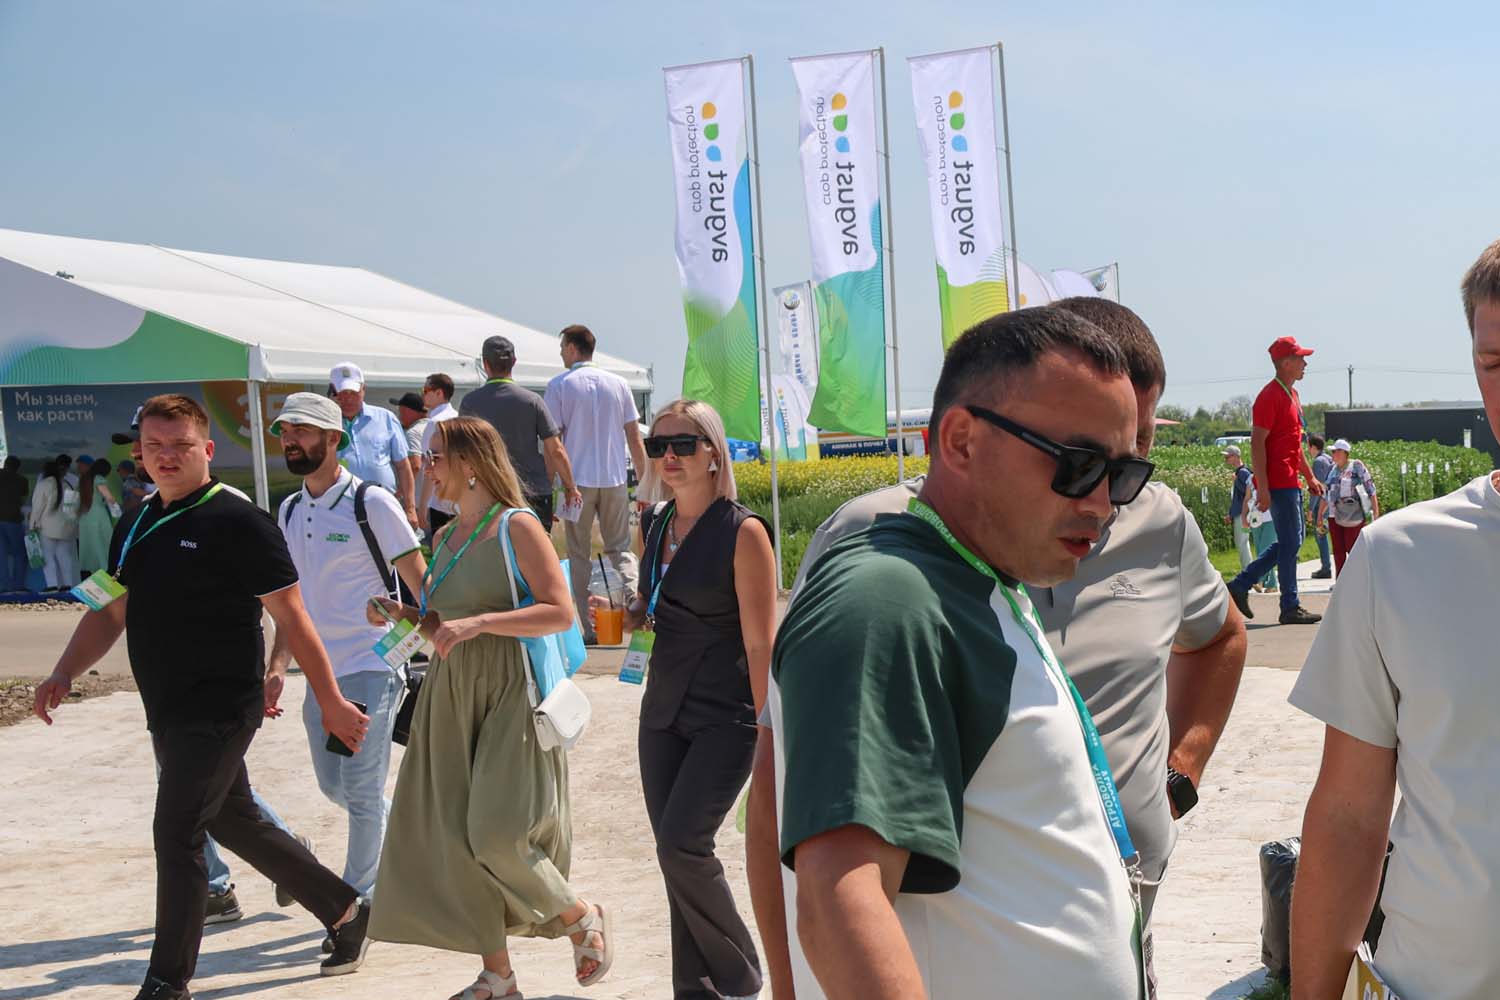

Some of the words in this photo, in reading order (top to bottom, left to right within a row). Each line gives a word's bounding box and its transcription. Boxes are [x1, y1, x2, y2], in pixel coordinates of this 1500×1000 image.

[15, 392, 43, 406] Мы
[47, 391, 98, 407] знаем,
[17, 408, 44, 422] как
[48, 408, 95, 424] расти
[179, 539, 198, 549] BOSS
